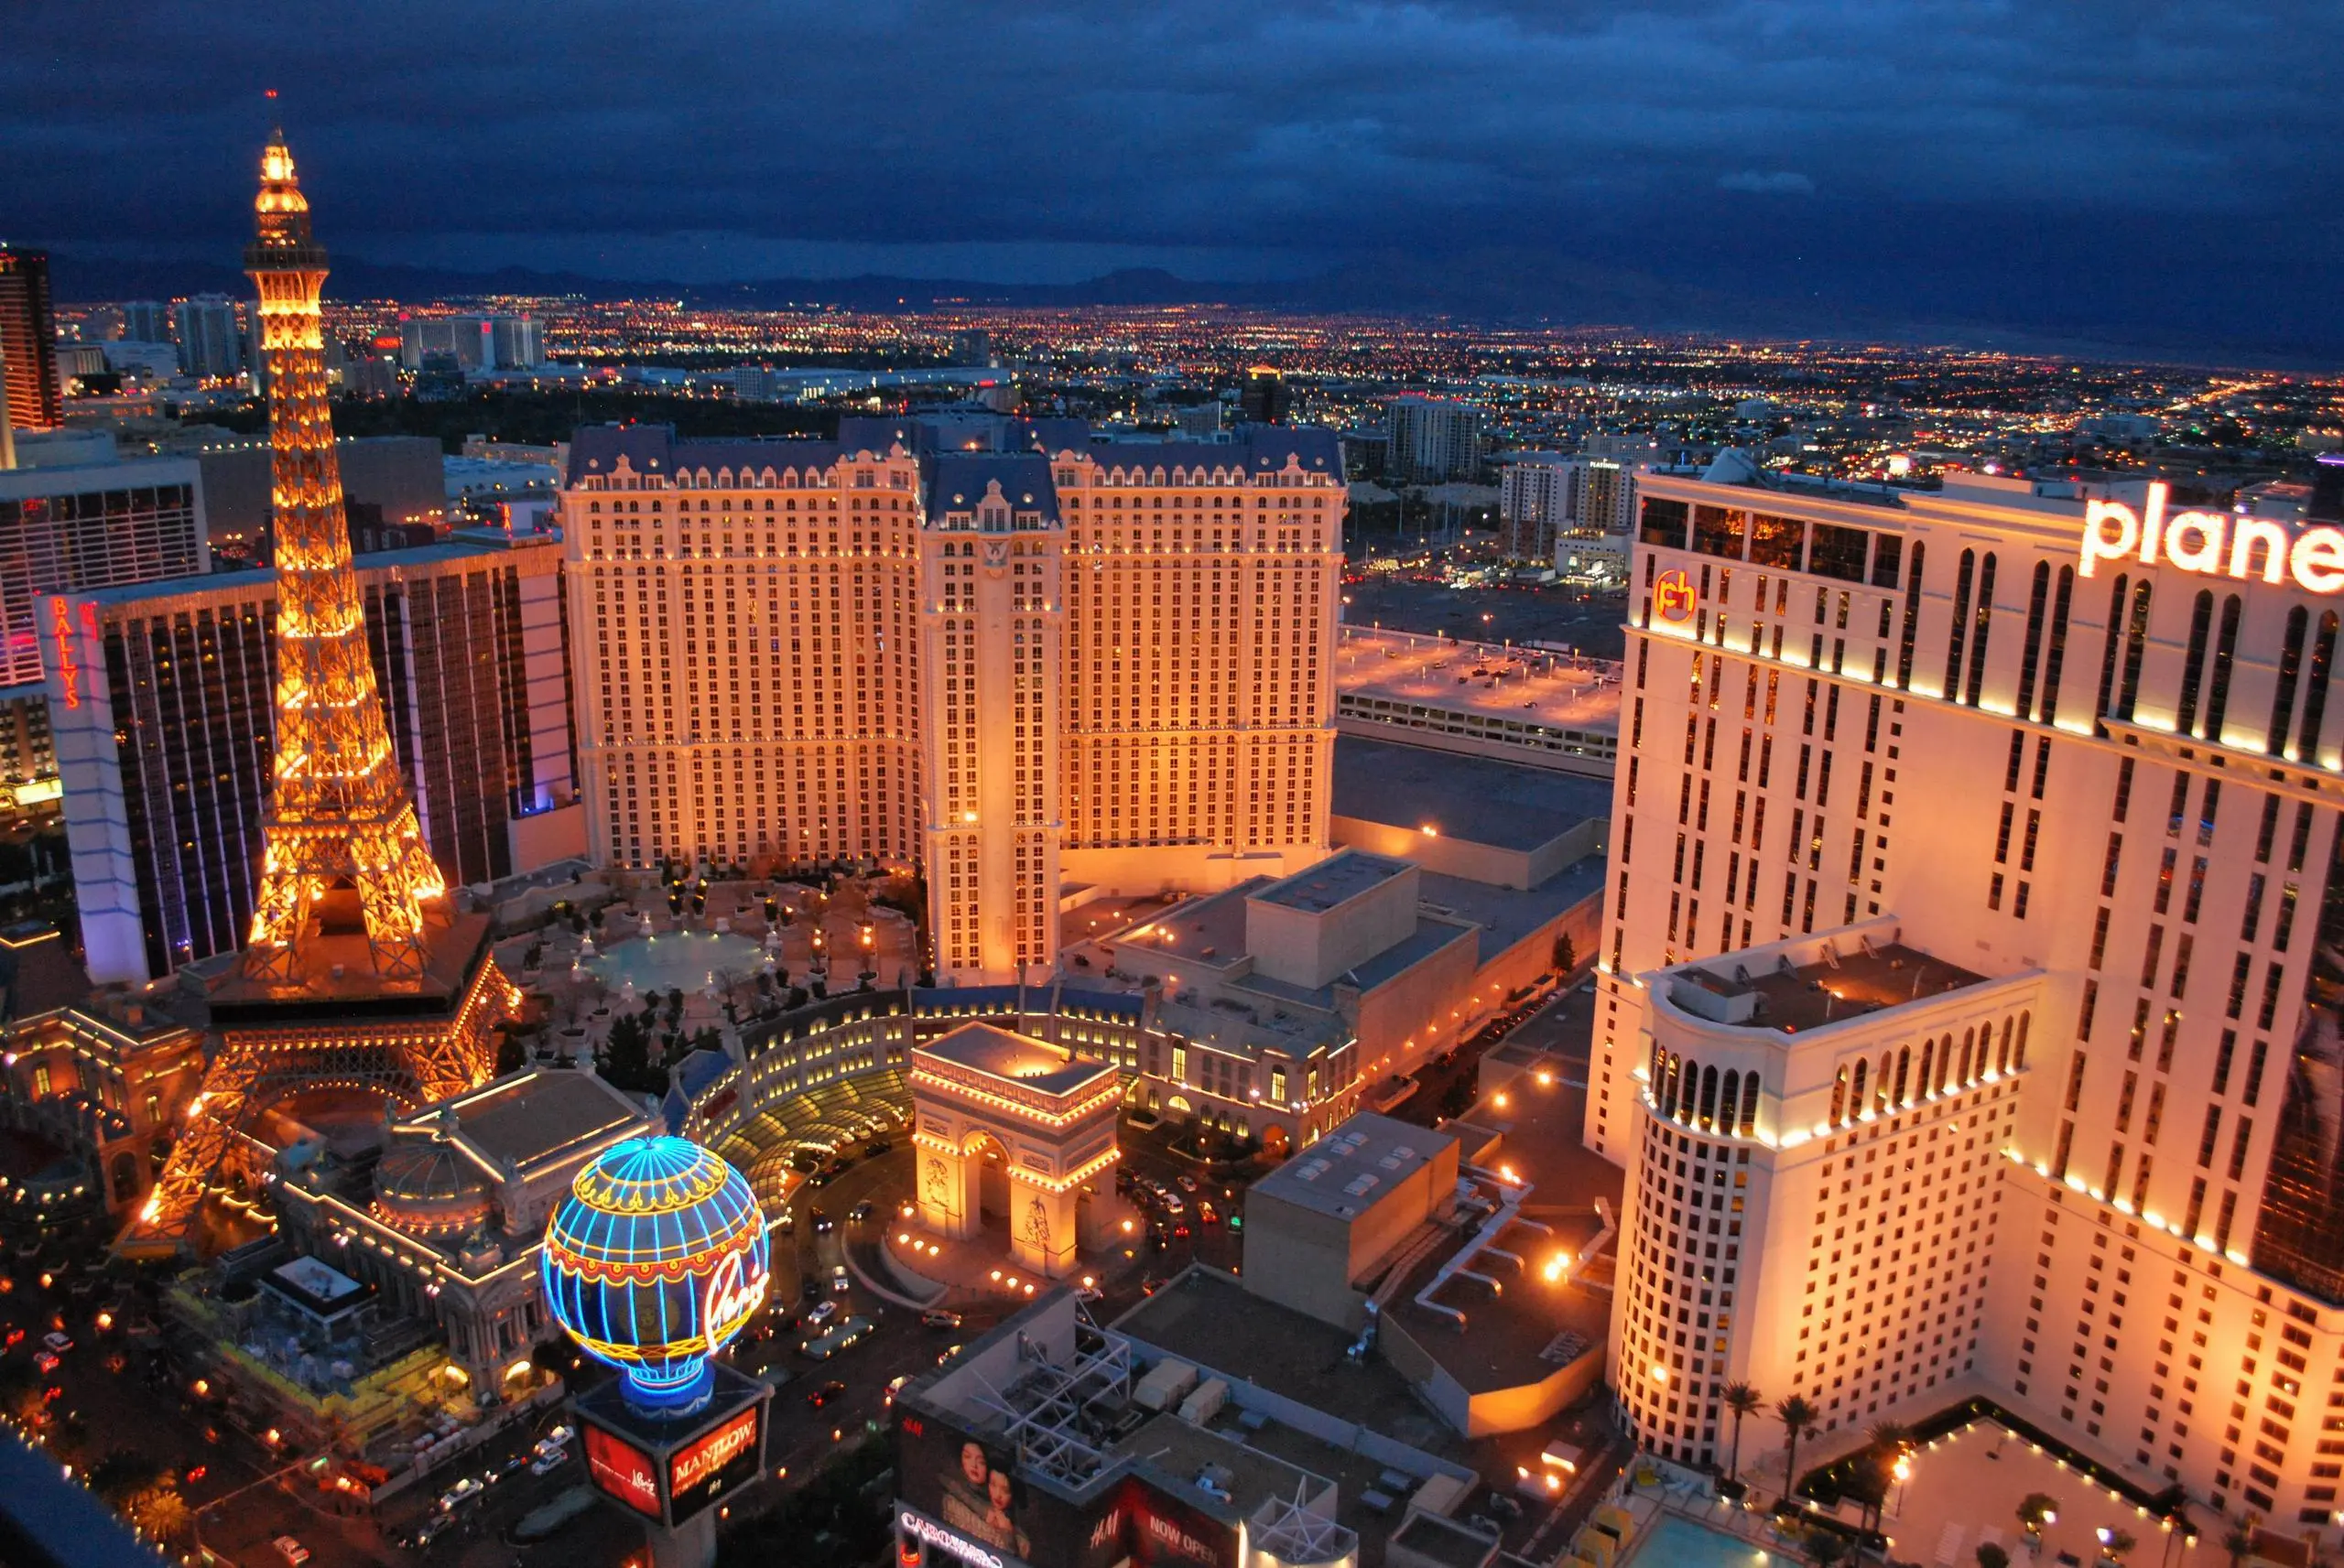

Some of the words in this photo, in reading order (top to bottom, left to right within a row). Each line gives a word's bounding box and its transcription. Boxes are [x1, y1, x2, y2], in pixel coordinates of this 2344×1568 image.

[2078, 481, 2344, 593] plane
[704, 1249, 770, 1356] Paris
[1150, 1515, 1180, 1544] NOW
[1183, 1534, 1218, 1566] OPEN
